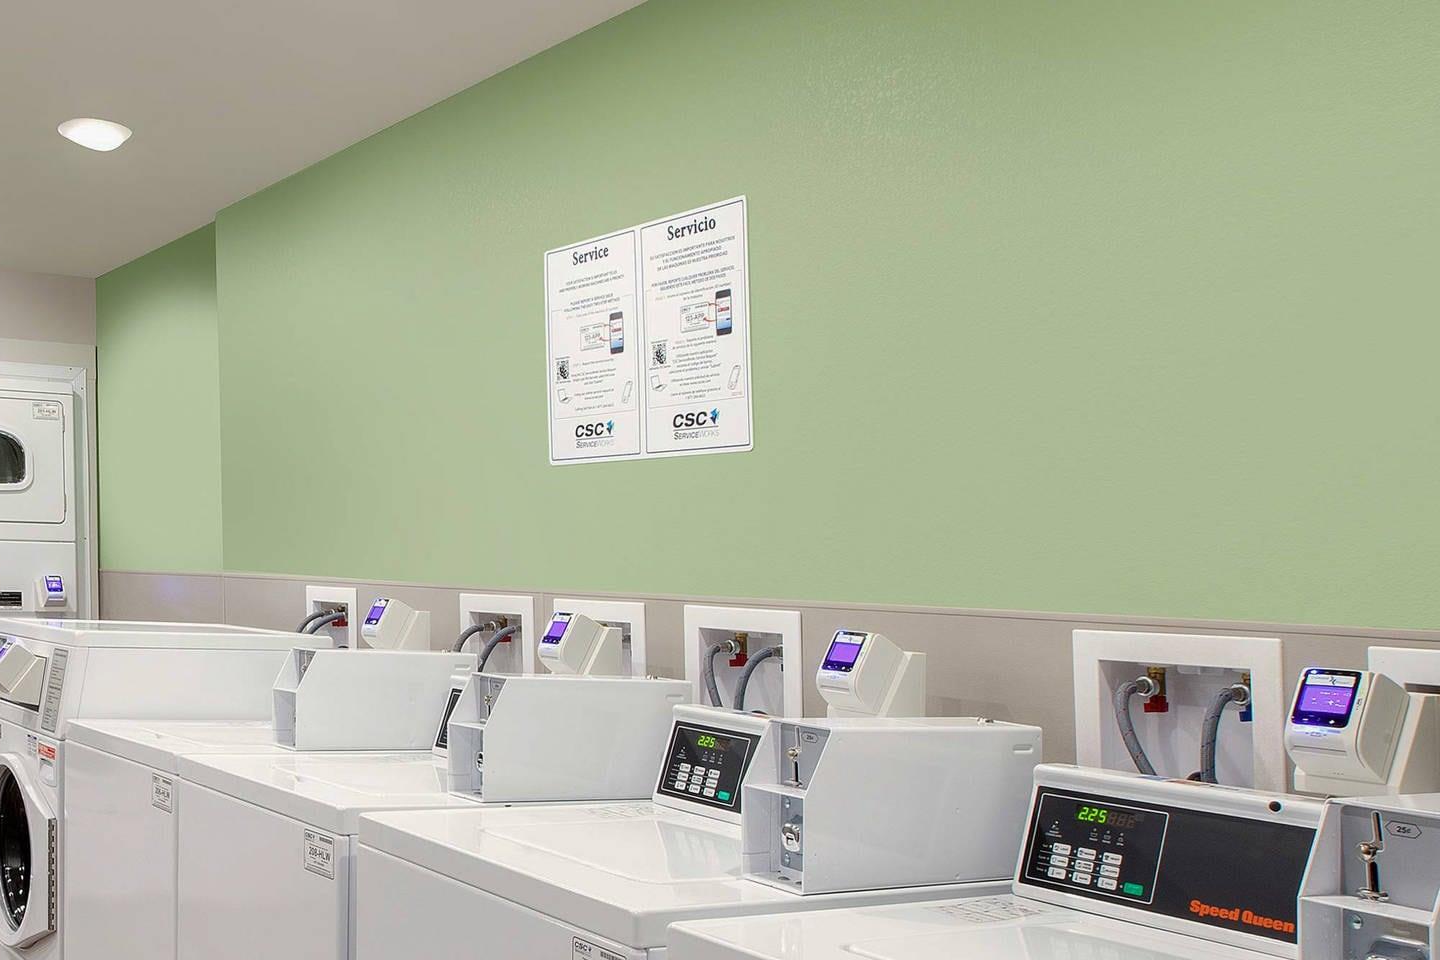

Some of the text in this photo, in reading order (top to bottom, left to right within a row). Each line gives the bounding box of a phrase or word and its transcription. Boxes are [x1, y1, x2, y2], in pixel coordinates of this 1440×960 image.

[667, 216, 716, 240] Servicio
[572, 246, 609, 266] Service
[672, 411, 708, 428] CSC
[575, 422, 604, 438] CSC
[1189, 899, 1296, 934] Speed Queen
